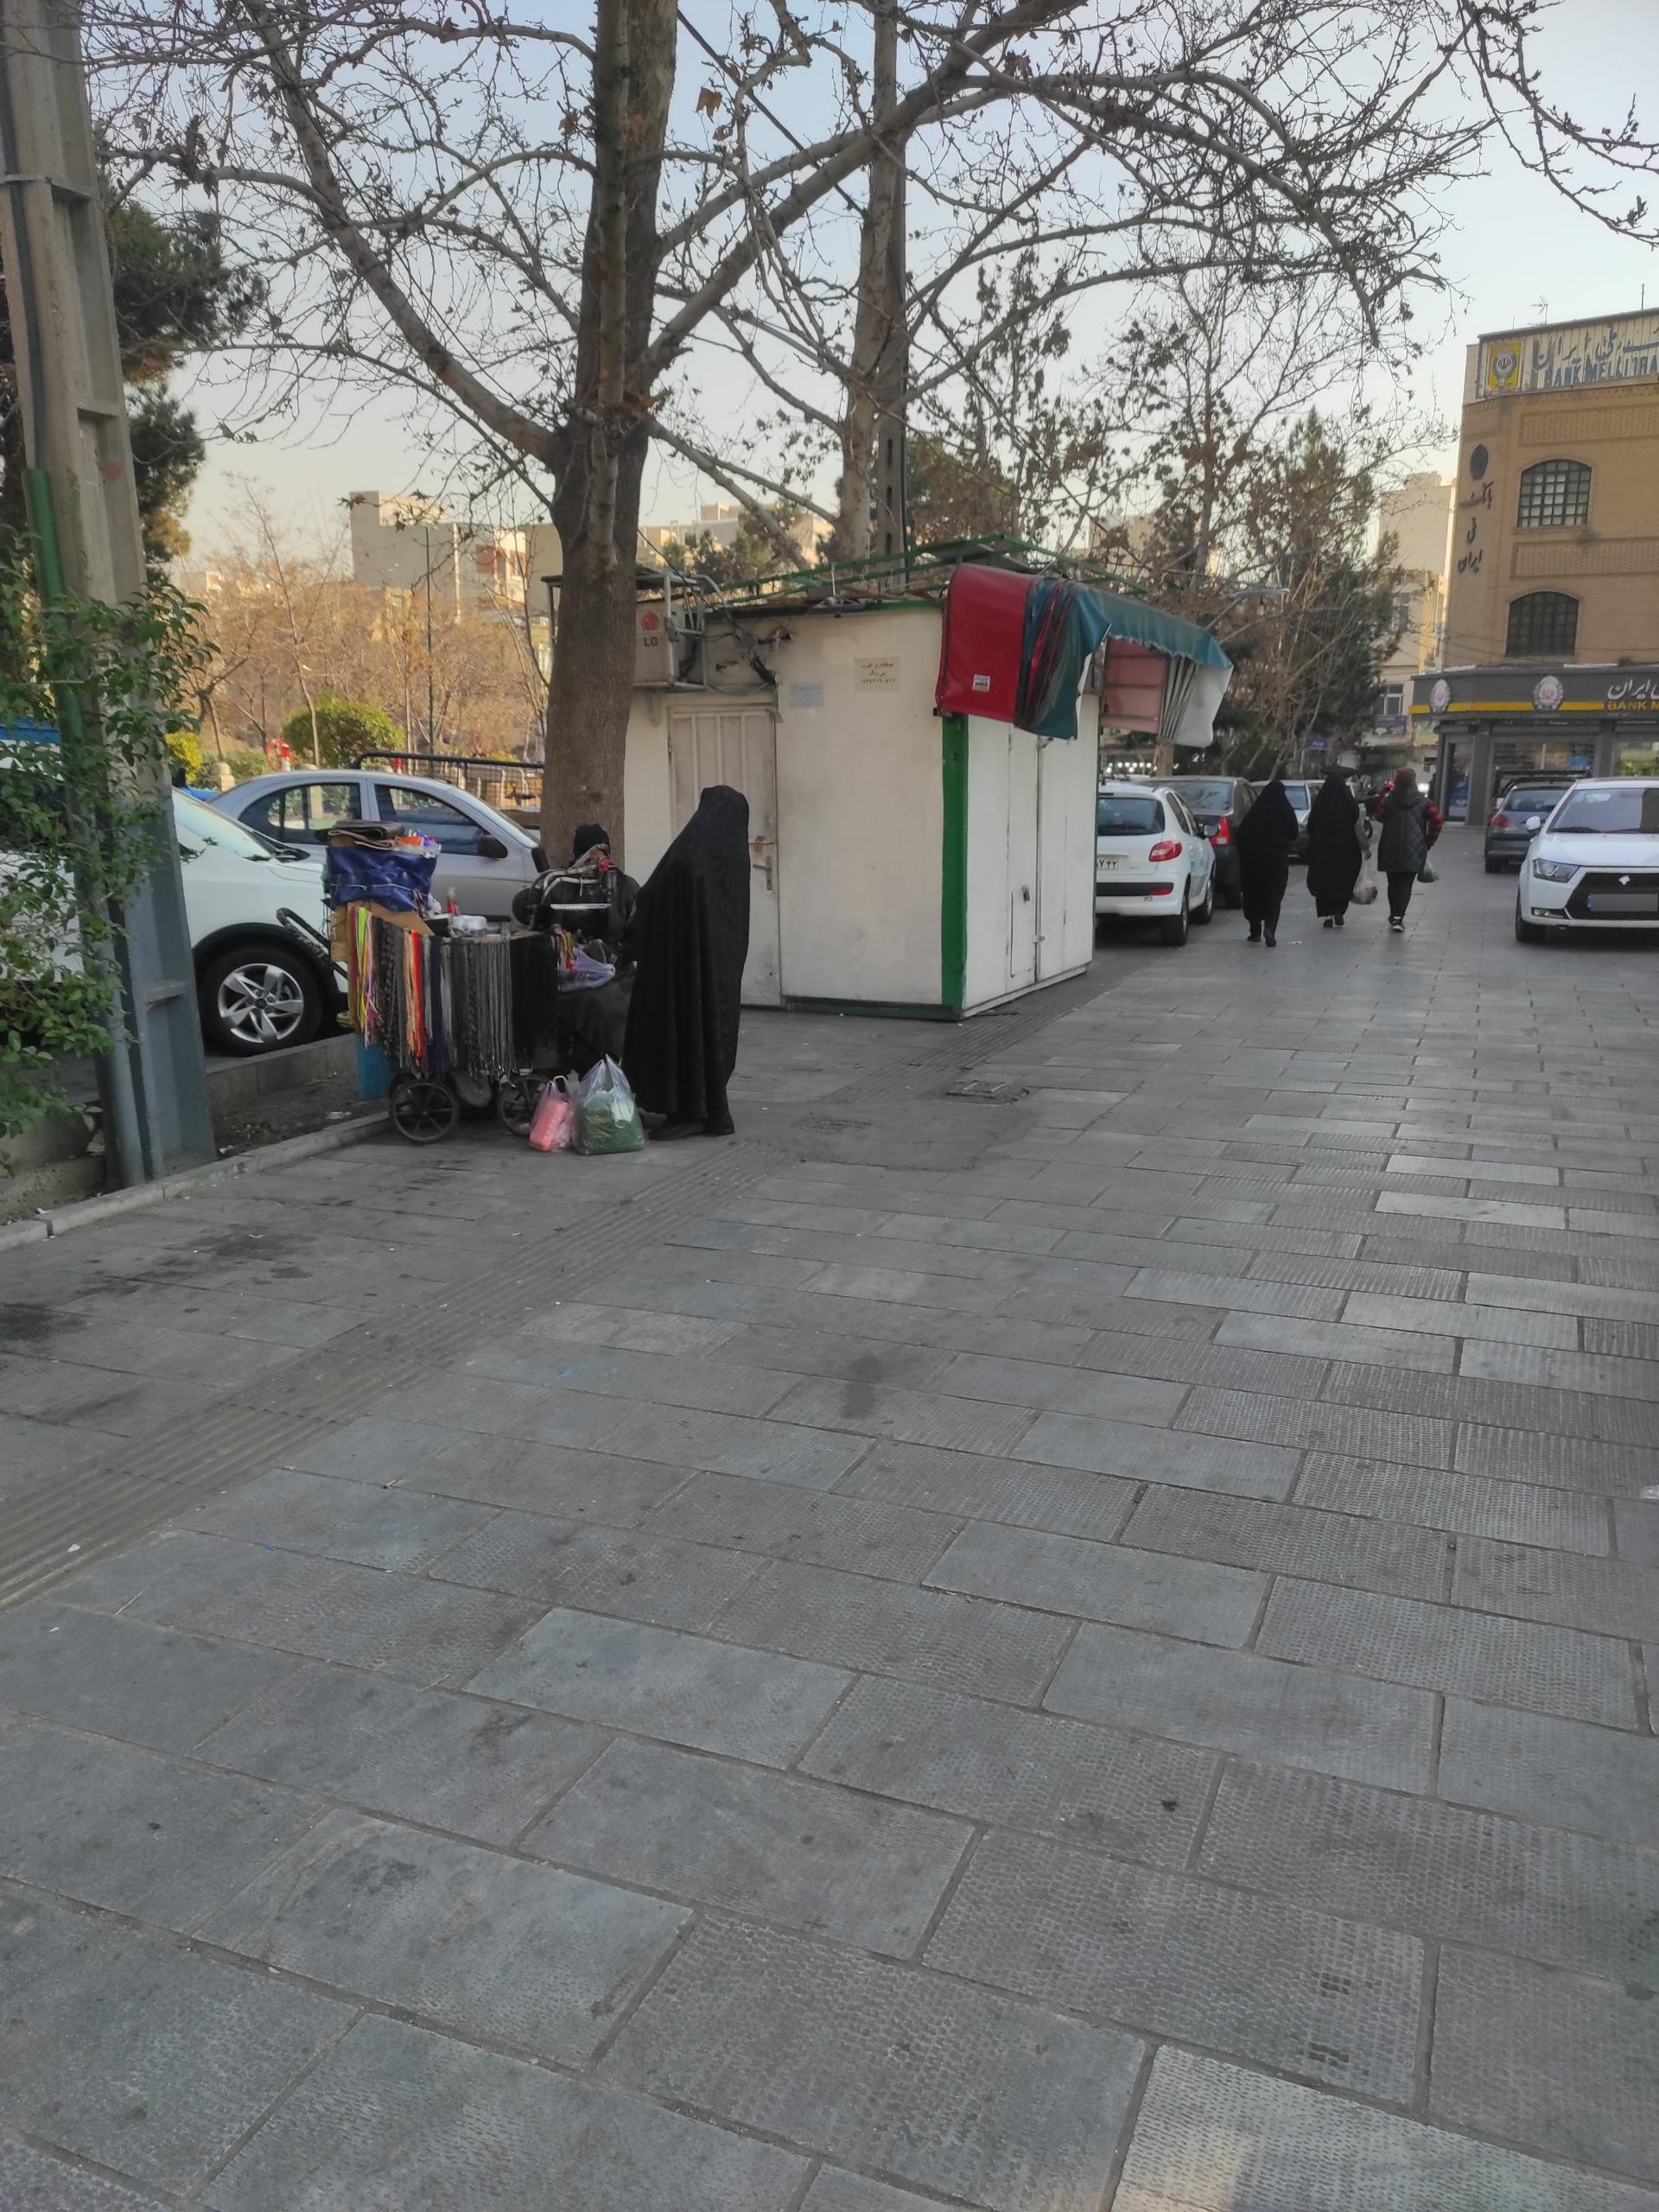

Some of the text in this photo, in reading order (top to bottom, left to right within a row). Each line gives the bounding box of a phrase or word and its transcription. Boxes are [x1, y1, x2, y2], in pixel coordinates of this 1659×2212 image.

[1544, 364, 1581, 390] BANK
[1459, 480, 1494, 510] بانک
[1458, 549, 1483, 574] ایران
[644, 636, 658, 647] LG
[1607, 678, 1651, 700] ایران
[1607, 701, 1646, 711] BANK
